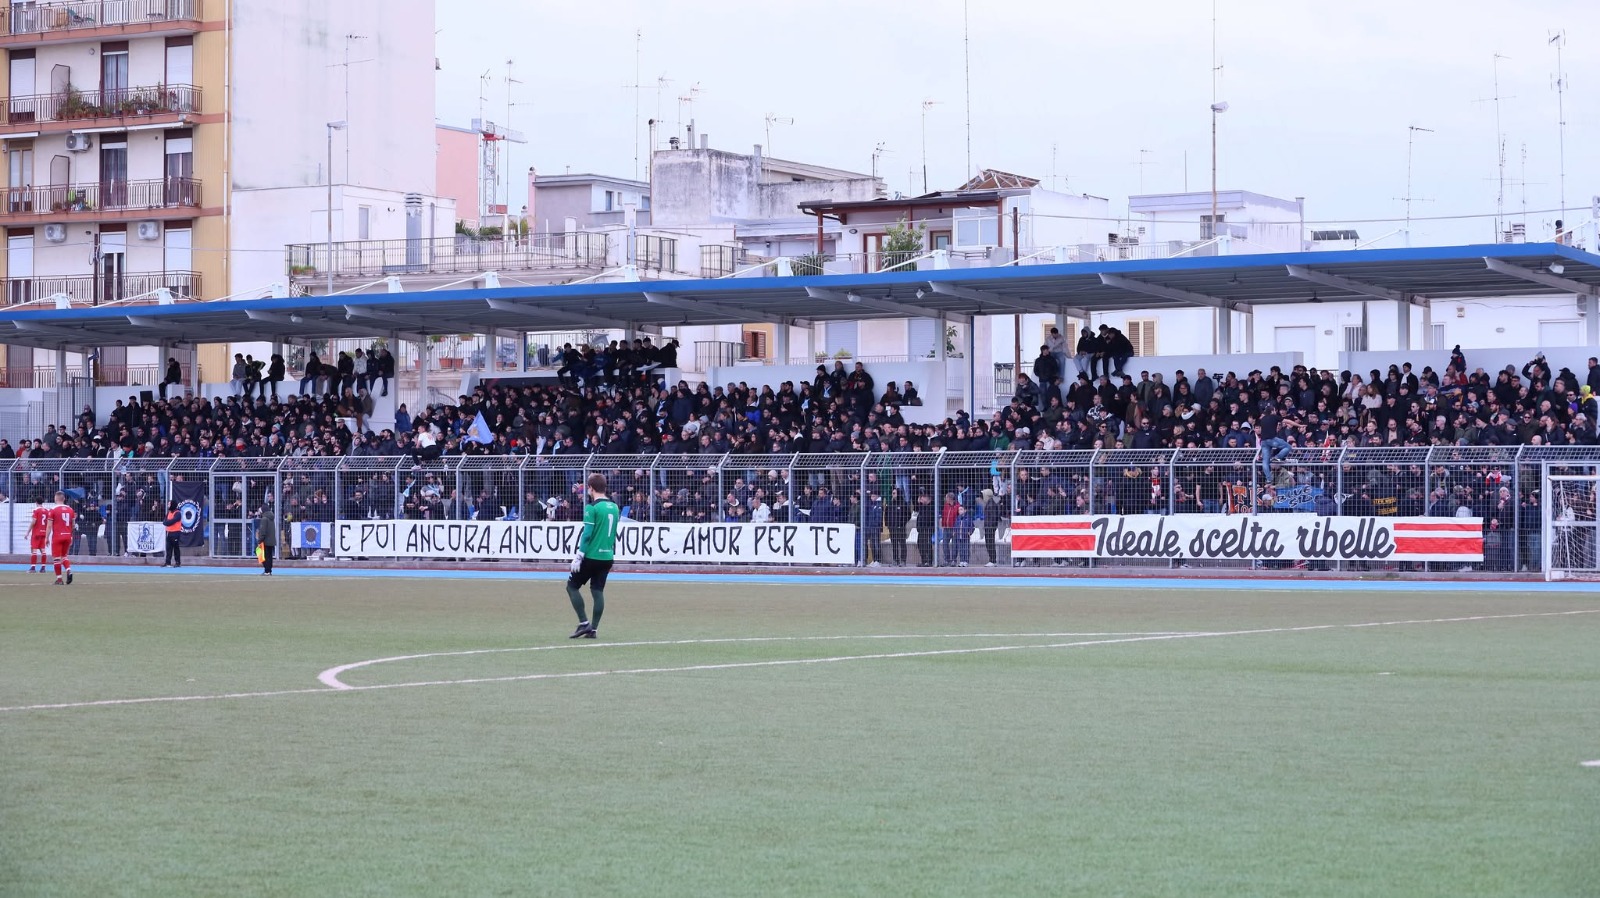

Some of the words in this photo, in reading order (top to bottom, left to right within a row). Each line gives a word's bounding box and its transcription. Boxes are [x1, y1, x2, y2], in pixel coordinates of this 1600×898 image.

[41, 513, 47, 526] 2
[61, 512, 70, 527] 4
[607, 513, 614, 537] 1
[339, 524, 351, 552] E
[361, 523, 396, 553] POI
[406, 523, 496, 556] ANCORA,
[613, 525, 678, 556] MORE,
[683, 525, 743, 556] AMOR
[754, 525, 798, 556] PER
[810, 525, 841, 556] TE
[1091, 516, 1184, 558] Ideale,
[1188, 516, 1285, 559] scelta
[1295, 516, 1395, 559] ribelle
